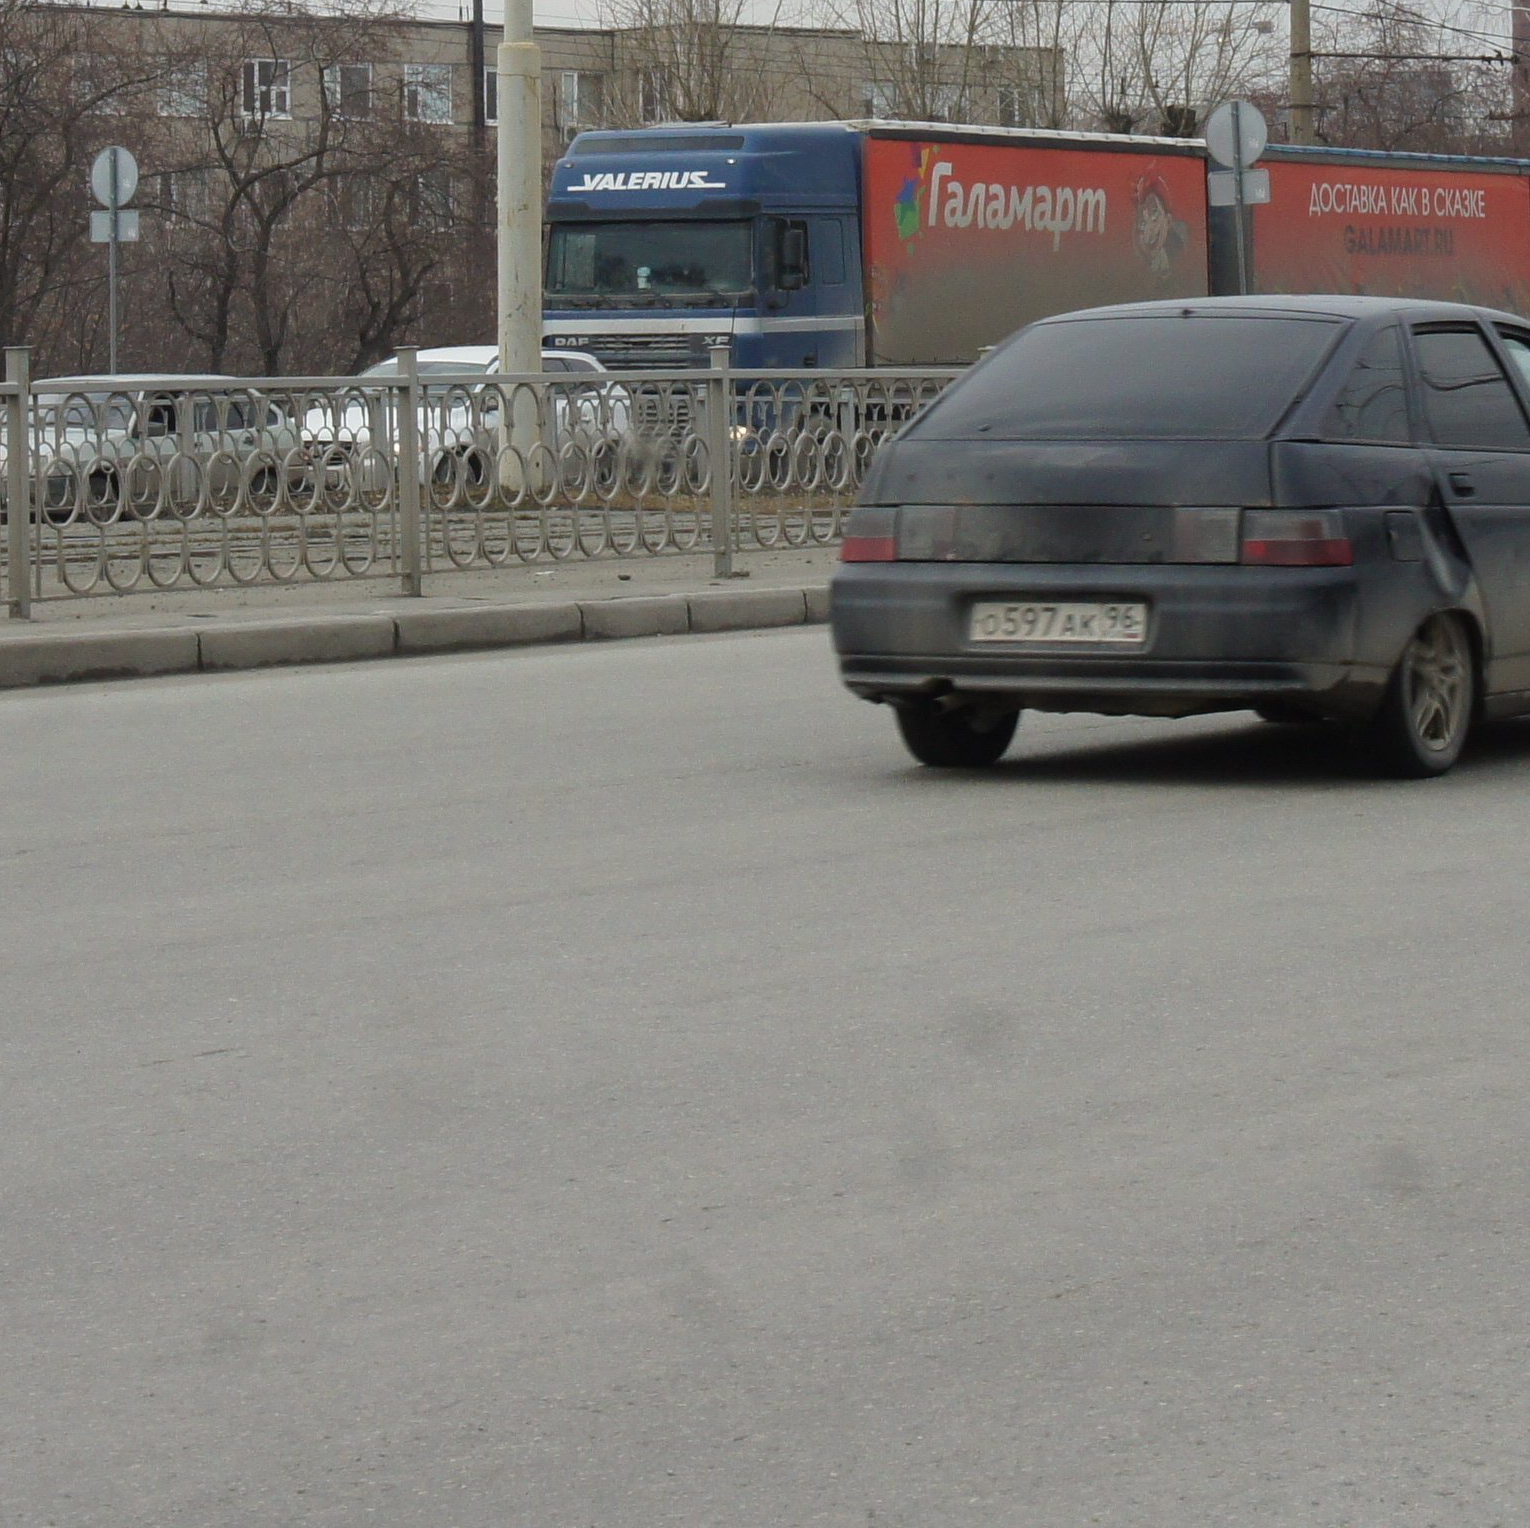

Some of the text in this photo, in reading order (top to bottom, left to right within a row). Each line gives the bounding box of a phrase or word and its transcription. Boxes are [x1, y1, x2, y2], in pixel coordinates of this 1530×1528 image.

[567, 171, 725, 191] VALERIUS
[928, 162, 1106, 251] Галамарт
[1308, 182, 1485, 218] ДОСТАВКА КАК В СКАЗКЕ
[1343, 224, 1454, 256] GALAMART.RU
[554, 336, 590, 347] DAF
[701, 336, 731, 346] XF
